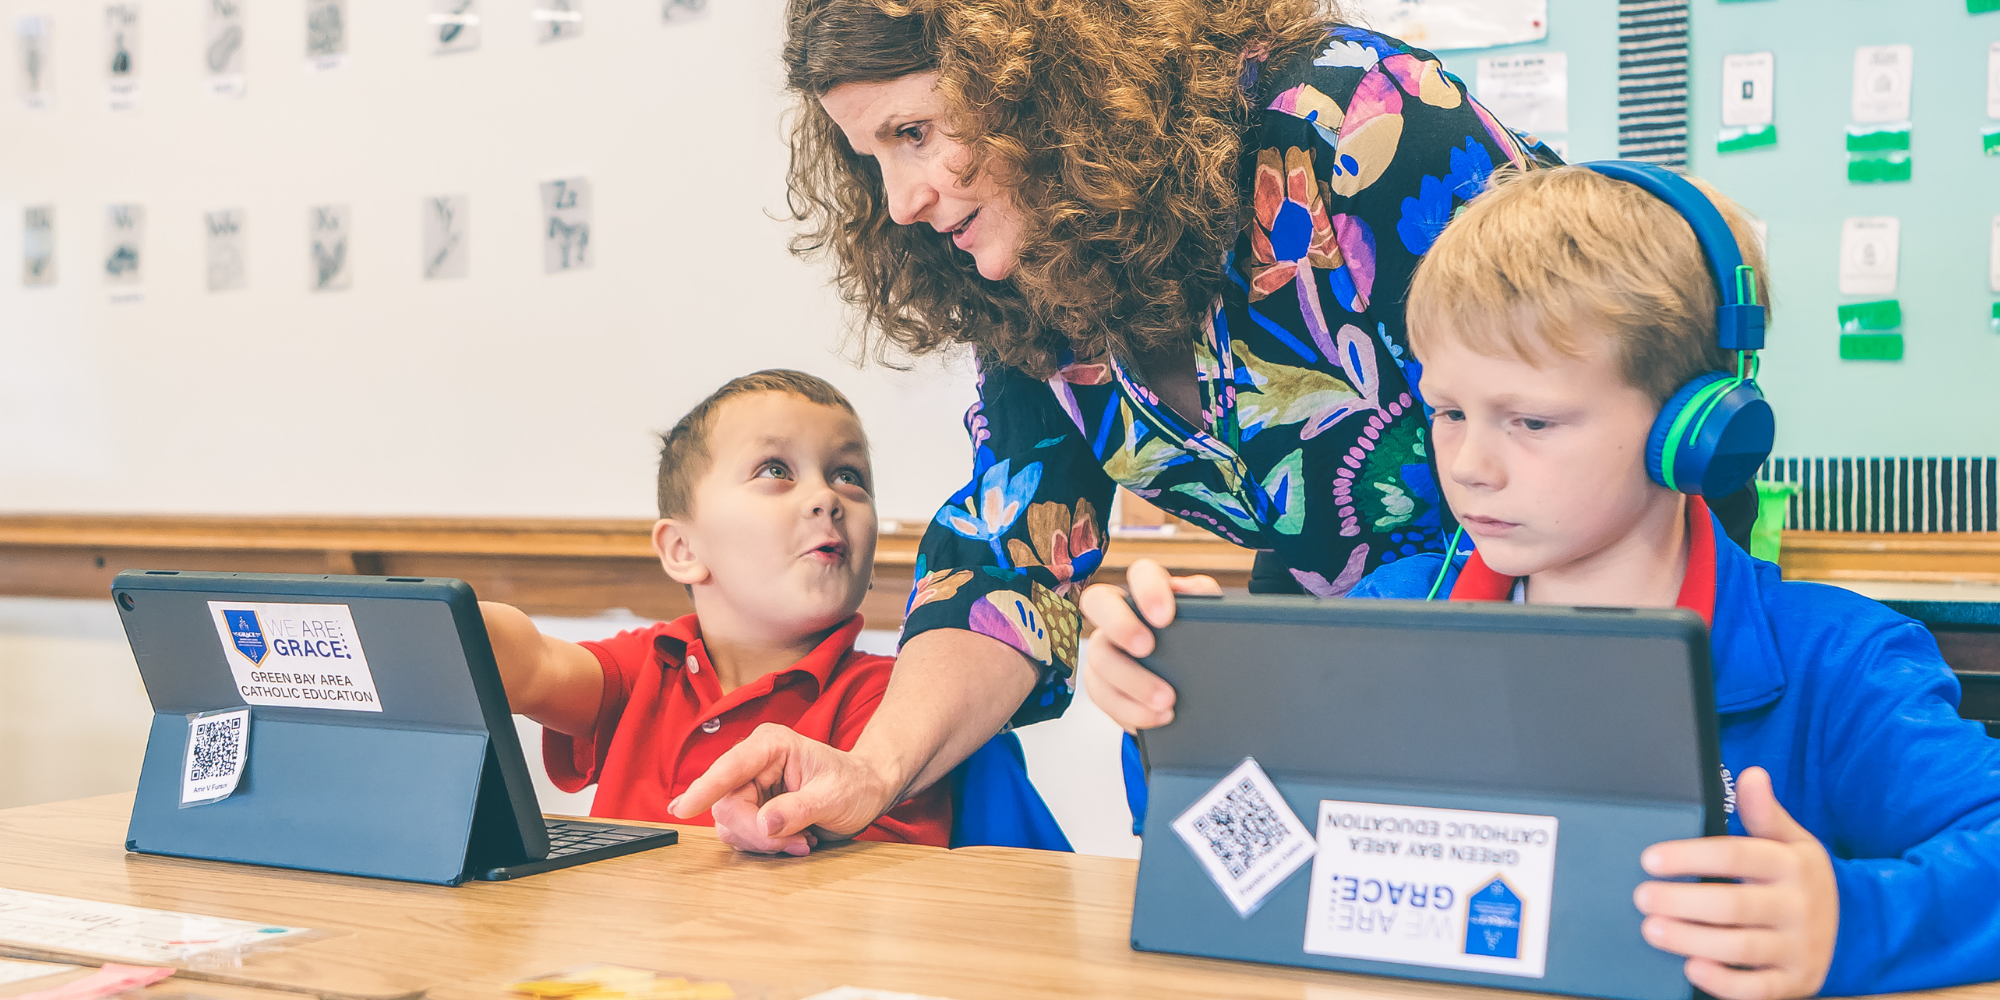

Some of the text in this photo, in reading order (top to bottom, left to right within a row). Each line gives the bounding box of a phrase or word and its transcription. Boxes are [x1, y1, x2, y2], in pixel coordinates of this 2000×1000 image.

[264, 618, 299, 638] WE
[250, 671, 353, 687] GREEN BAY AREA
[241, 685, 374, 703] CATHOLIC EDUCATION
[1324, 811, 1550, 847] CATHOLIC EDUCATION
[1349, 836, 1521, 867] GREEN BAY AREA
[1403, 913, 1455, 941] WE
